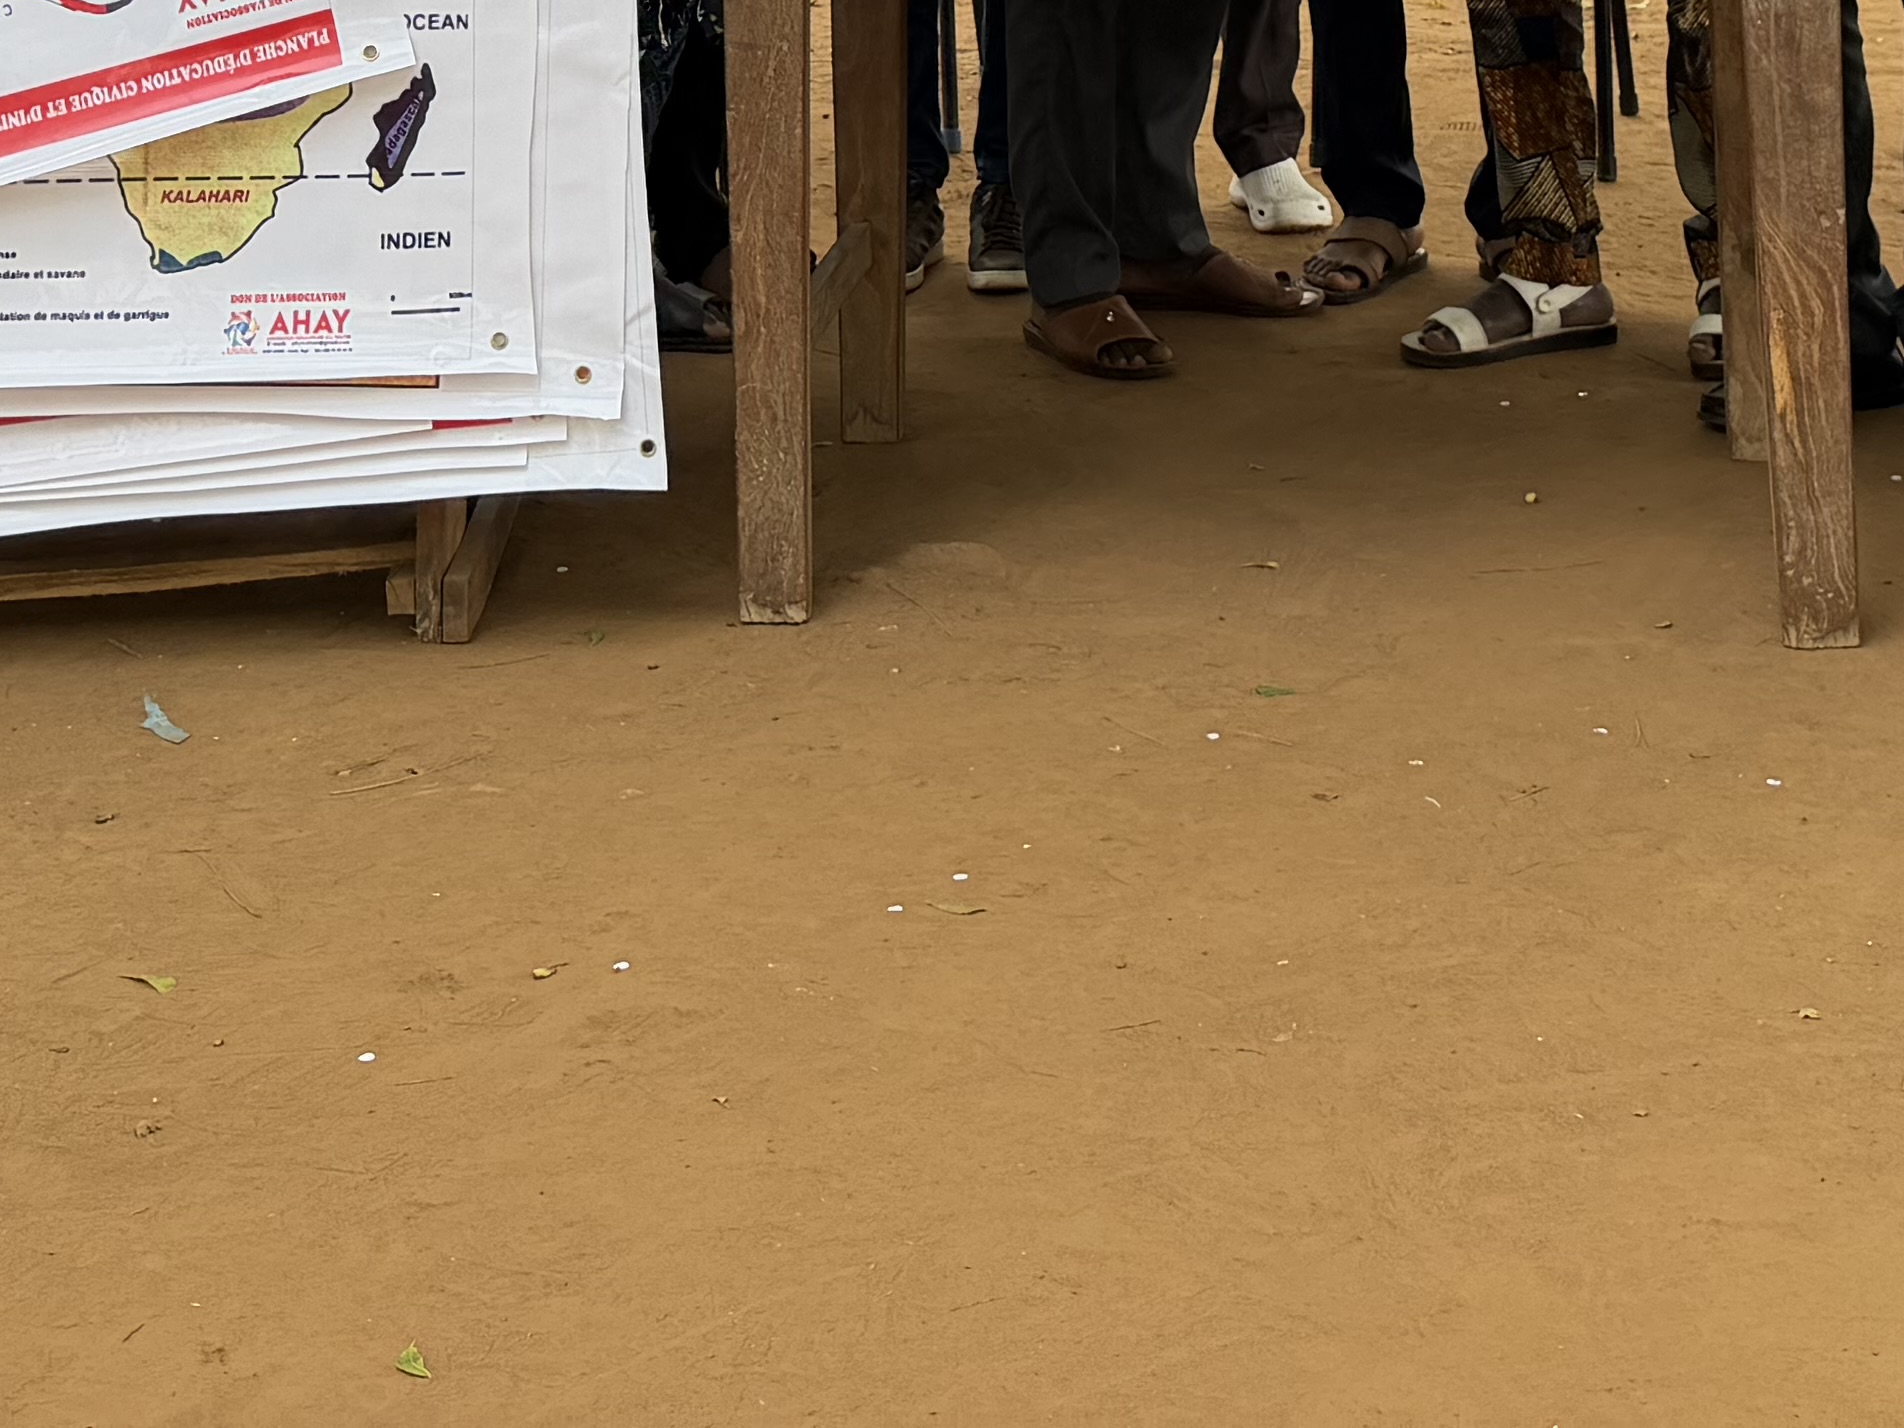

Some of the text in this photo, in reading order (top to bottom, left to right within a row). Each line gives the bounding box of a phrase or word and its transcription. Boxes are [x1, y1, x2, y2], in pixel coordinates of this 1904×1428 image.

[186, 0, 266, 29] L'ASSOCIATION
[257, 28, 330, 61] PLANCHE
[142, 48, 252, 93] D'ÉDUCATION
[71, 84, 138, 112] CIVIQUE
[46, 99, 68, 119] ET
[161, 190, 250, 204] KALAHARI
[380, 231, 451, 250] INDIEN
[33, 270, 44, 279] et
[47, 270, 86, 279] savane
[230, 292, 346, 304] DON DE L'ASSOCIATION
[34, 312, 46, 321] de
[50, 311, 91, 322] maquis
[93, 311, 104, 320] et
[107, 311, 121, 320] de
[123, 310, 170, 322] garrigue
[269, 309, 351, 335] AHAY
